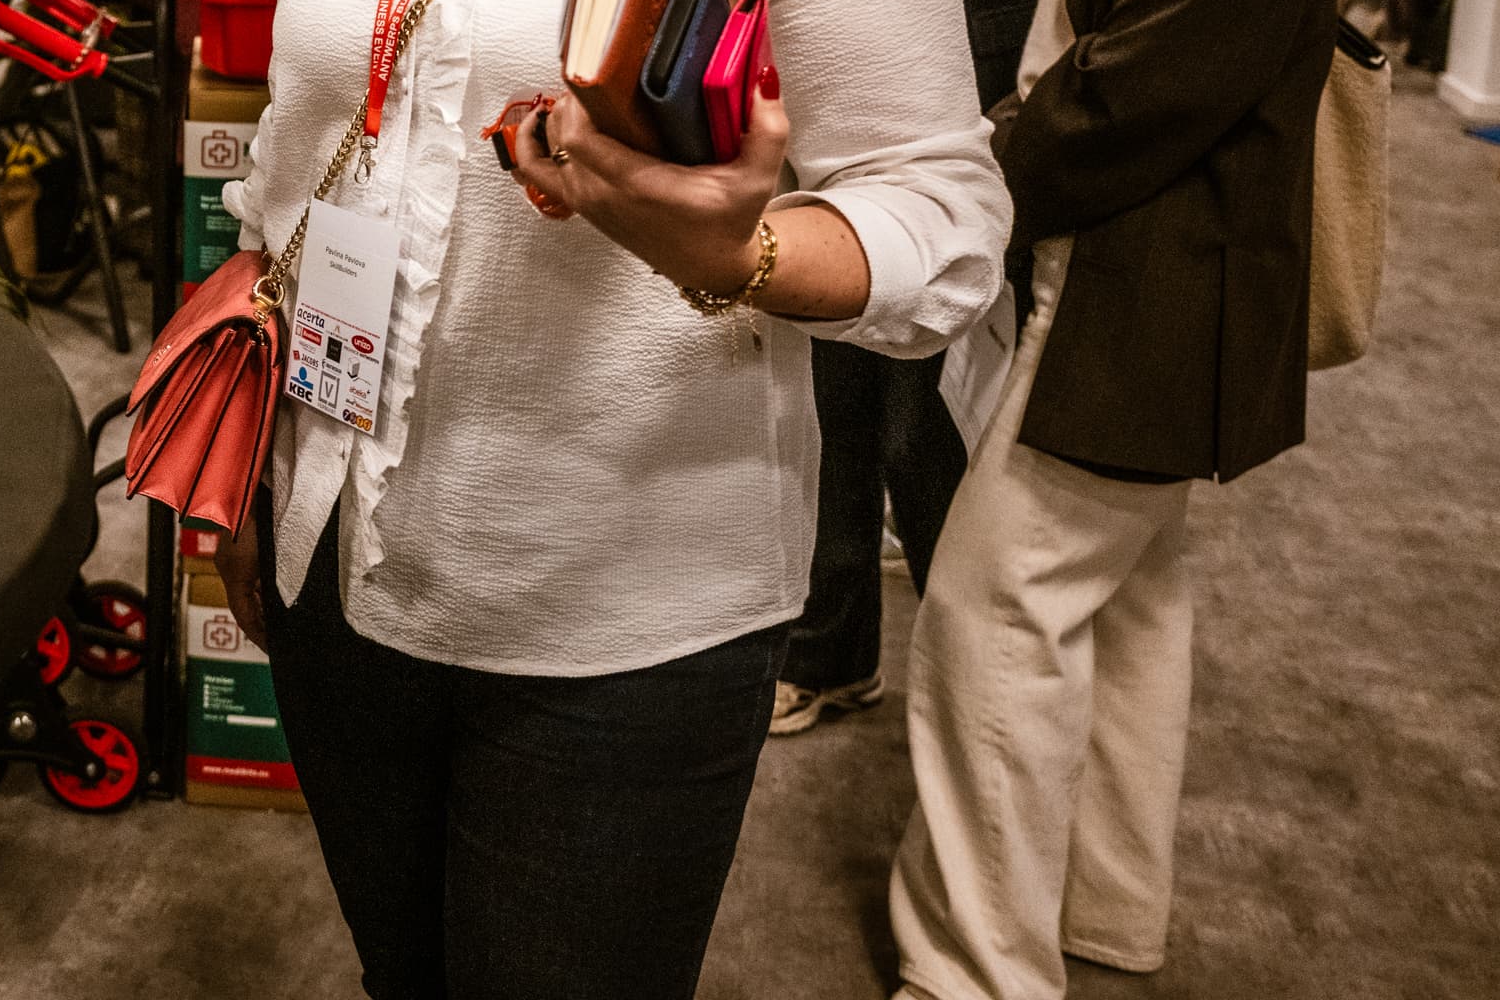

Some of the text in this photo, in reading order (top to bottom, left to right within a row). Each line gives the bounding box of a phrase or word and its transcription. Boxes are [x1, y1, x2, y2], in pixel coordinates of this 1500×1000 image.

[378, 16, 400, 82] ANTWERPS
[297, 308, 326, 329] acerta
[289, 382, 313, 403] KBC
